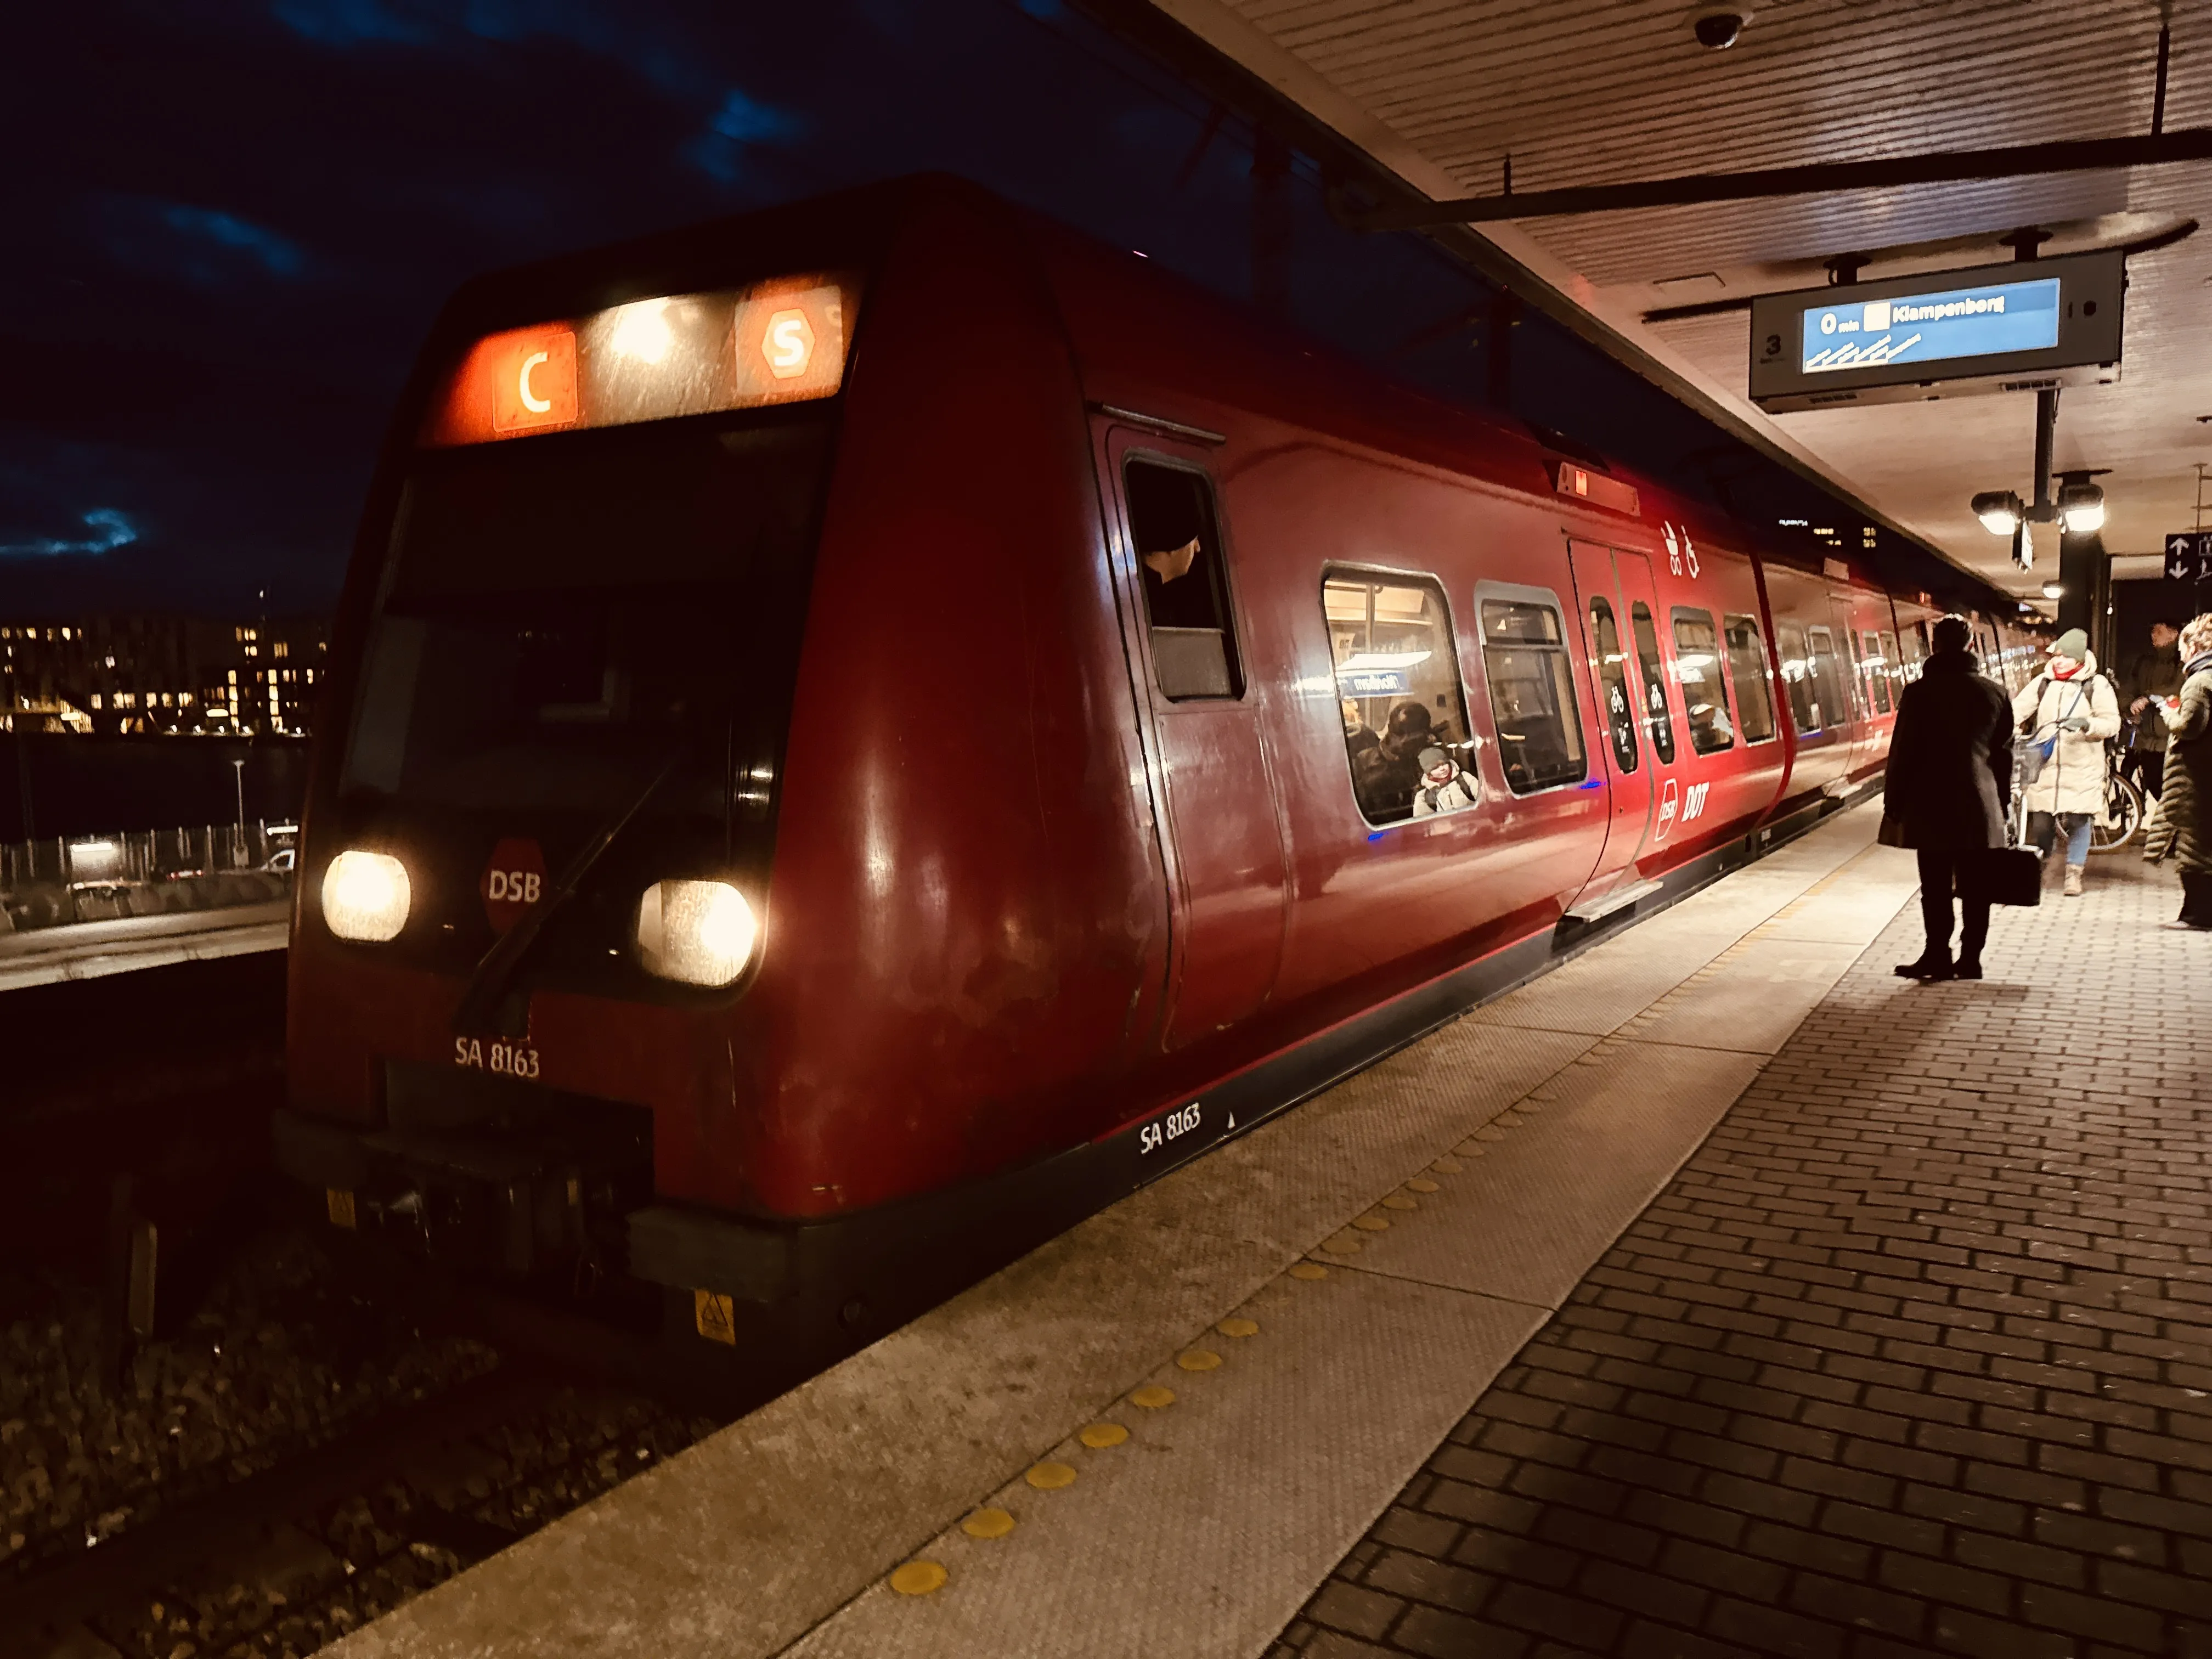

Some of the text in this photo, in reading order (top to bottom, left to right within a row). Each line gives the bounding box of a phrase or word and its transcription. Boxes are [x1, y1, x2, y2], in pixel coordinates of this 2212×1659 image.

[1821, 313, 1837, 335] 0
[1893, 295, 2005, 323] Klampenborg
[773, 320, 804, 366] S
[1765, 334, 1781, 356] 3
[518, 352, 551, 413] C
[1681, 781, 1709, 822] DOT
[489, 869, 540, 904] DSB
[455, 1036, 540, 1079] SA 8163
[1140, 1102, 1201, 1155] SA 8163
